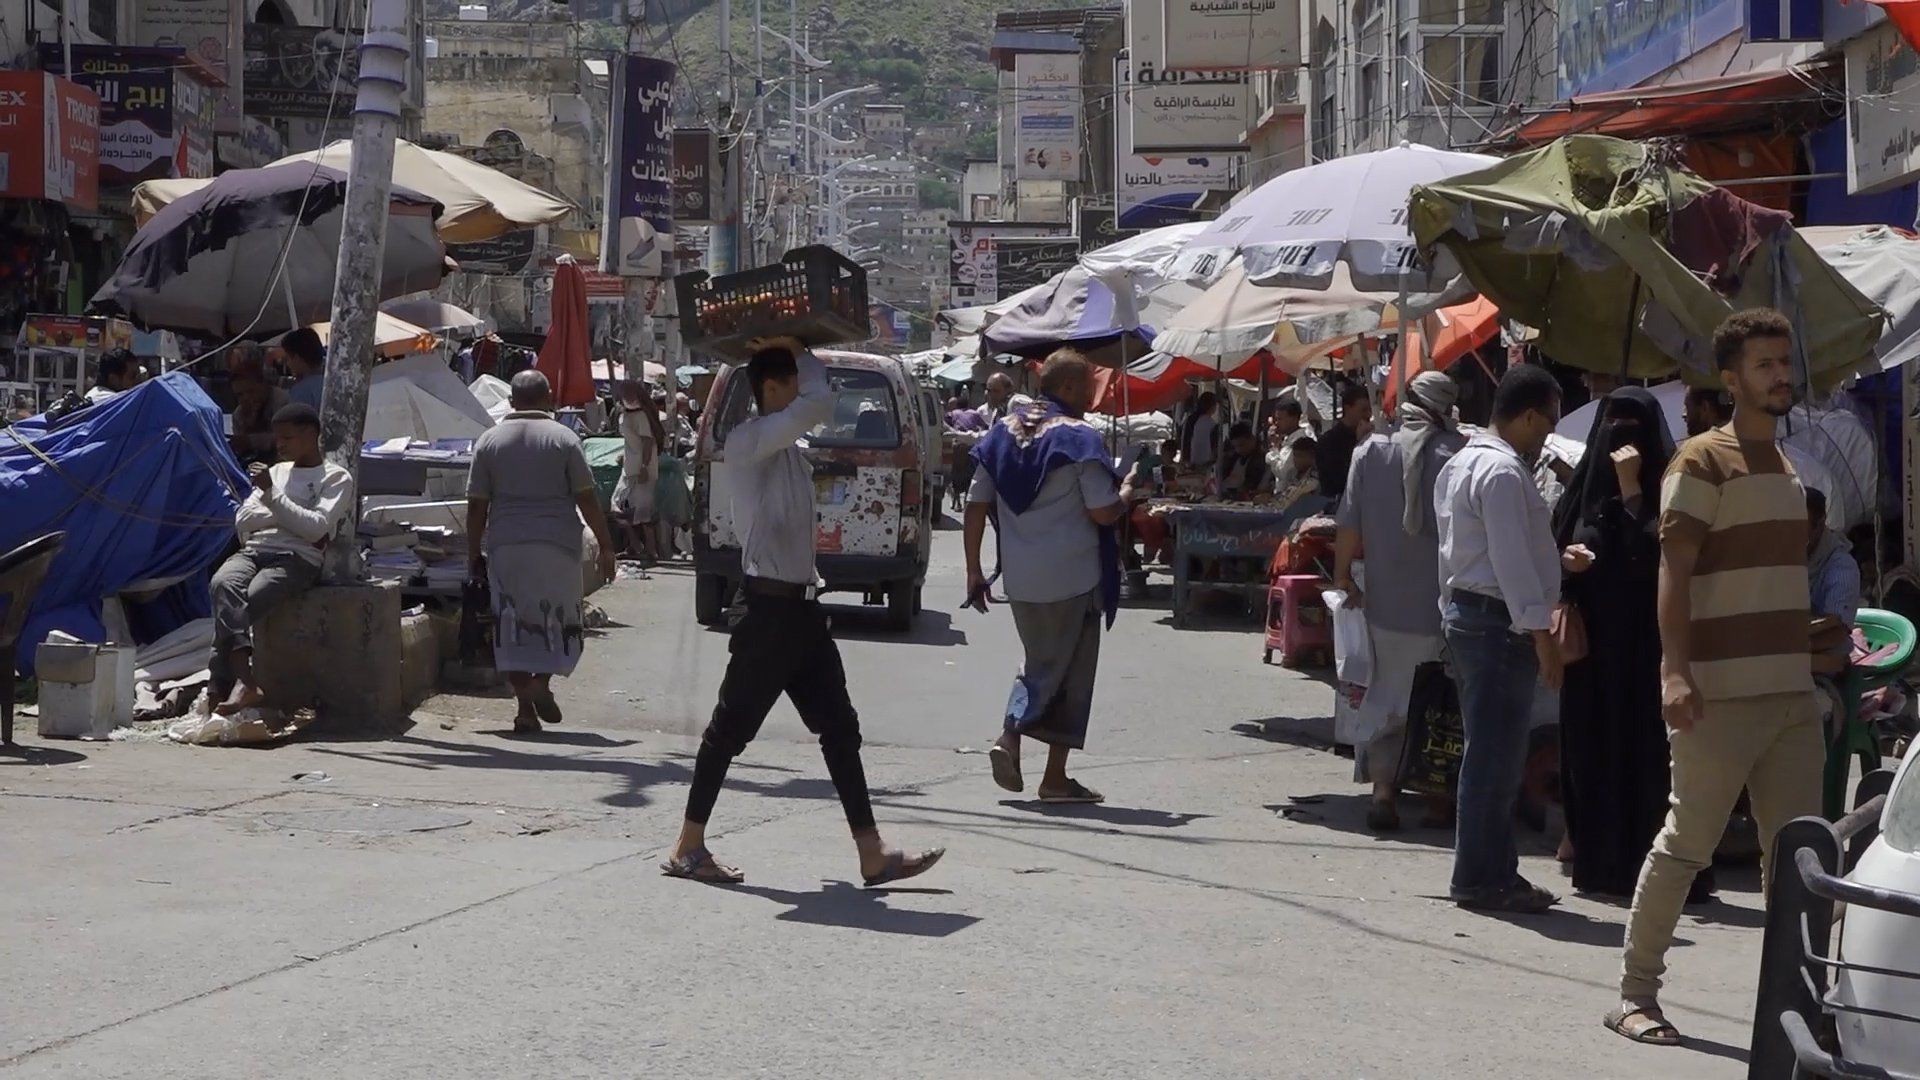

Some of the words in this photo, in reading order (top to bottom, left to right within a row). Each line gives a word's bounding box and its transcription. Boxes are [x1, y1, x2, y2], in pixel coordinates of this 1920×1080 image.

[96, 79, 119, 103] الت
[124, 86, 166, 110] برج
[1154, 96, 1190, 111] الراقية
[1192, 94, 1235, 110] للألبسة
[100, 149, 152, 160] والخردوا
[1125, 172, 1162, 188] بالدنيا
